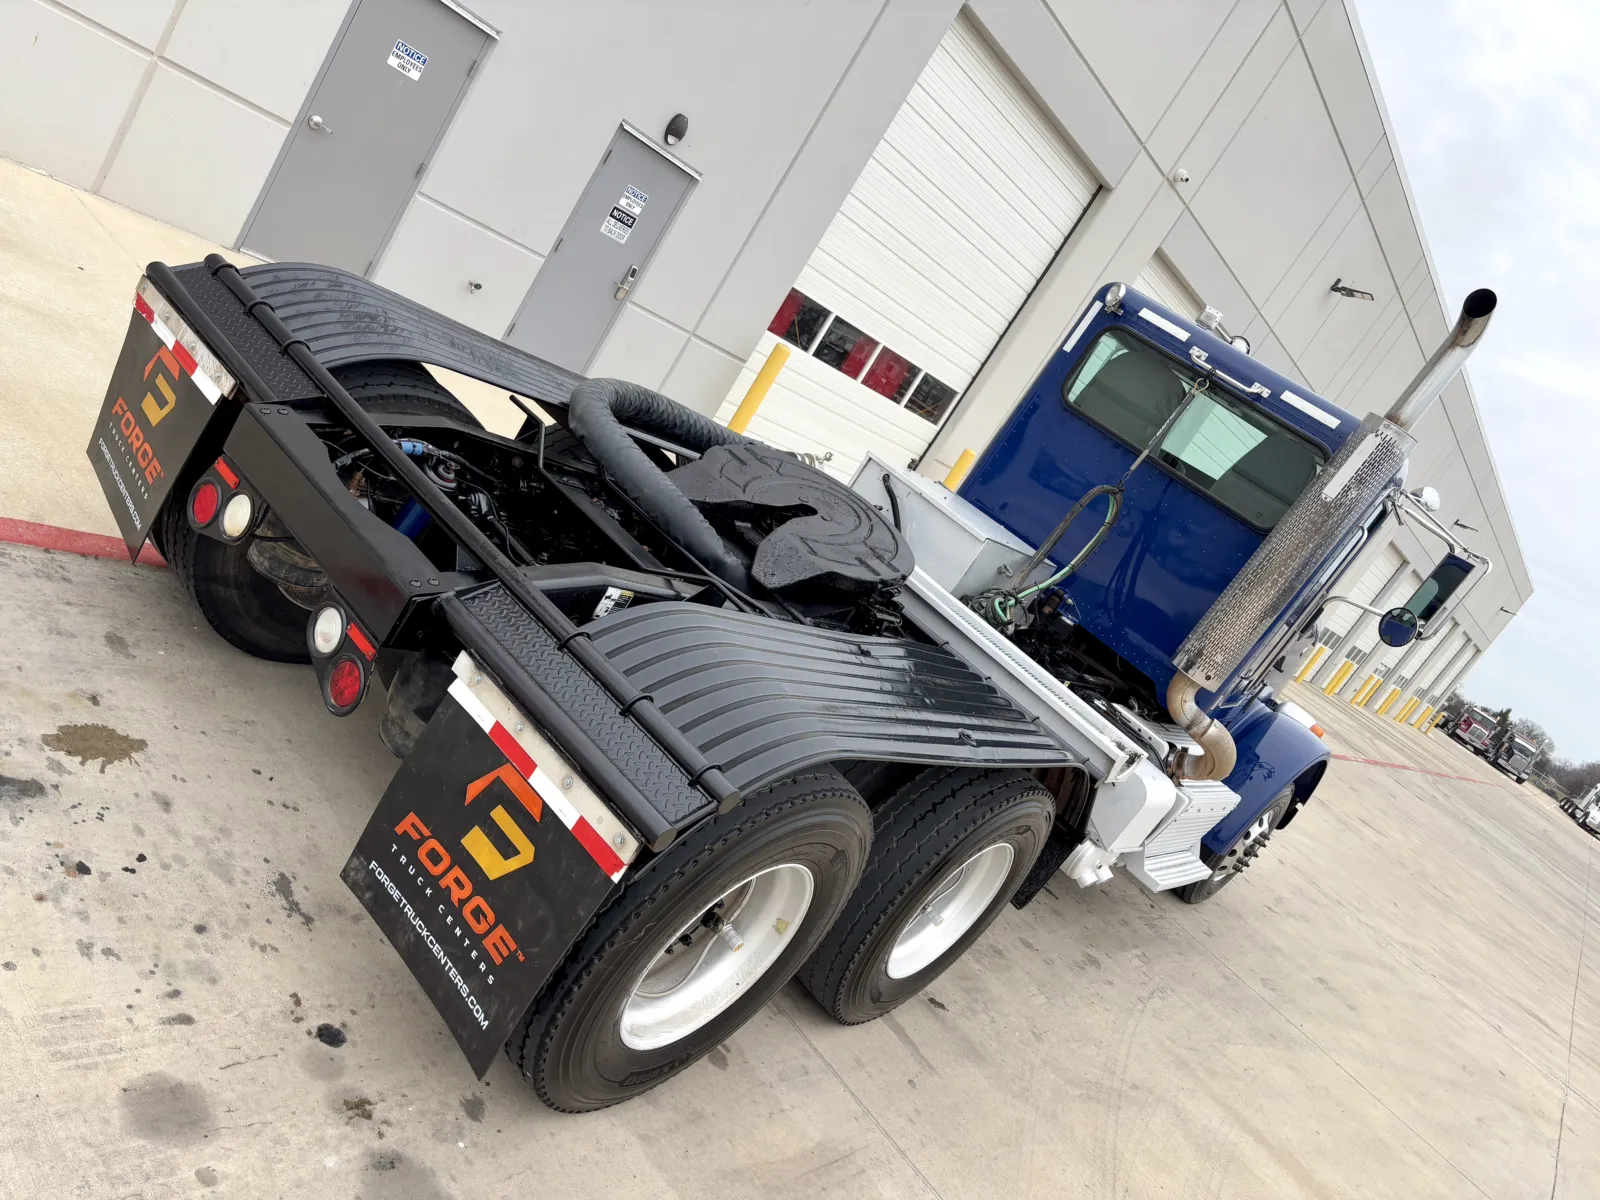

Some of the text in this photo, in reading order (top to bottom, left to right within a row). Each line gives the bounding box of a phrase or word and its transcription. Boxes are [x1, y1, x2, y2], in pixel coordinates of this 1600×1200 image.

[391, 50, 422, 72] EMPLOYEES
[396, 42, 426, 65] NOTICE
[397, 61, 411, 73] ONLY
[622, 193, 644, 208] EMPLOYEES
[625, 201, 635, 209] ONLY
[626, 186, 648, 204] NOTICE
[611, 208, 635, 226] NOTICE
[111, 396, 162, 486] FORGE
[108, 421, 149, 500] TRUCK CENTERS
[98, 437, 142, 532] FORGETRUCKCENTERS.COM
[394, 811, 518, 966] FORGE
[391, 843, 495, 986] TRUCK CENTERS
[368, 860, 490, 1031] FORGETRUCKCENTERS.COM
